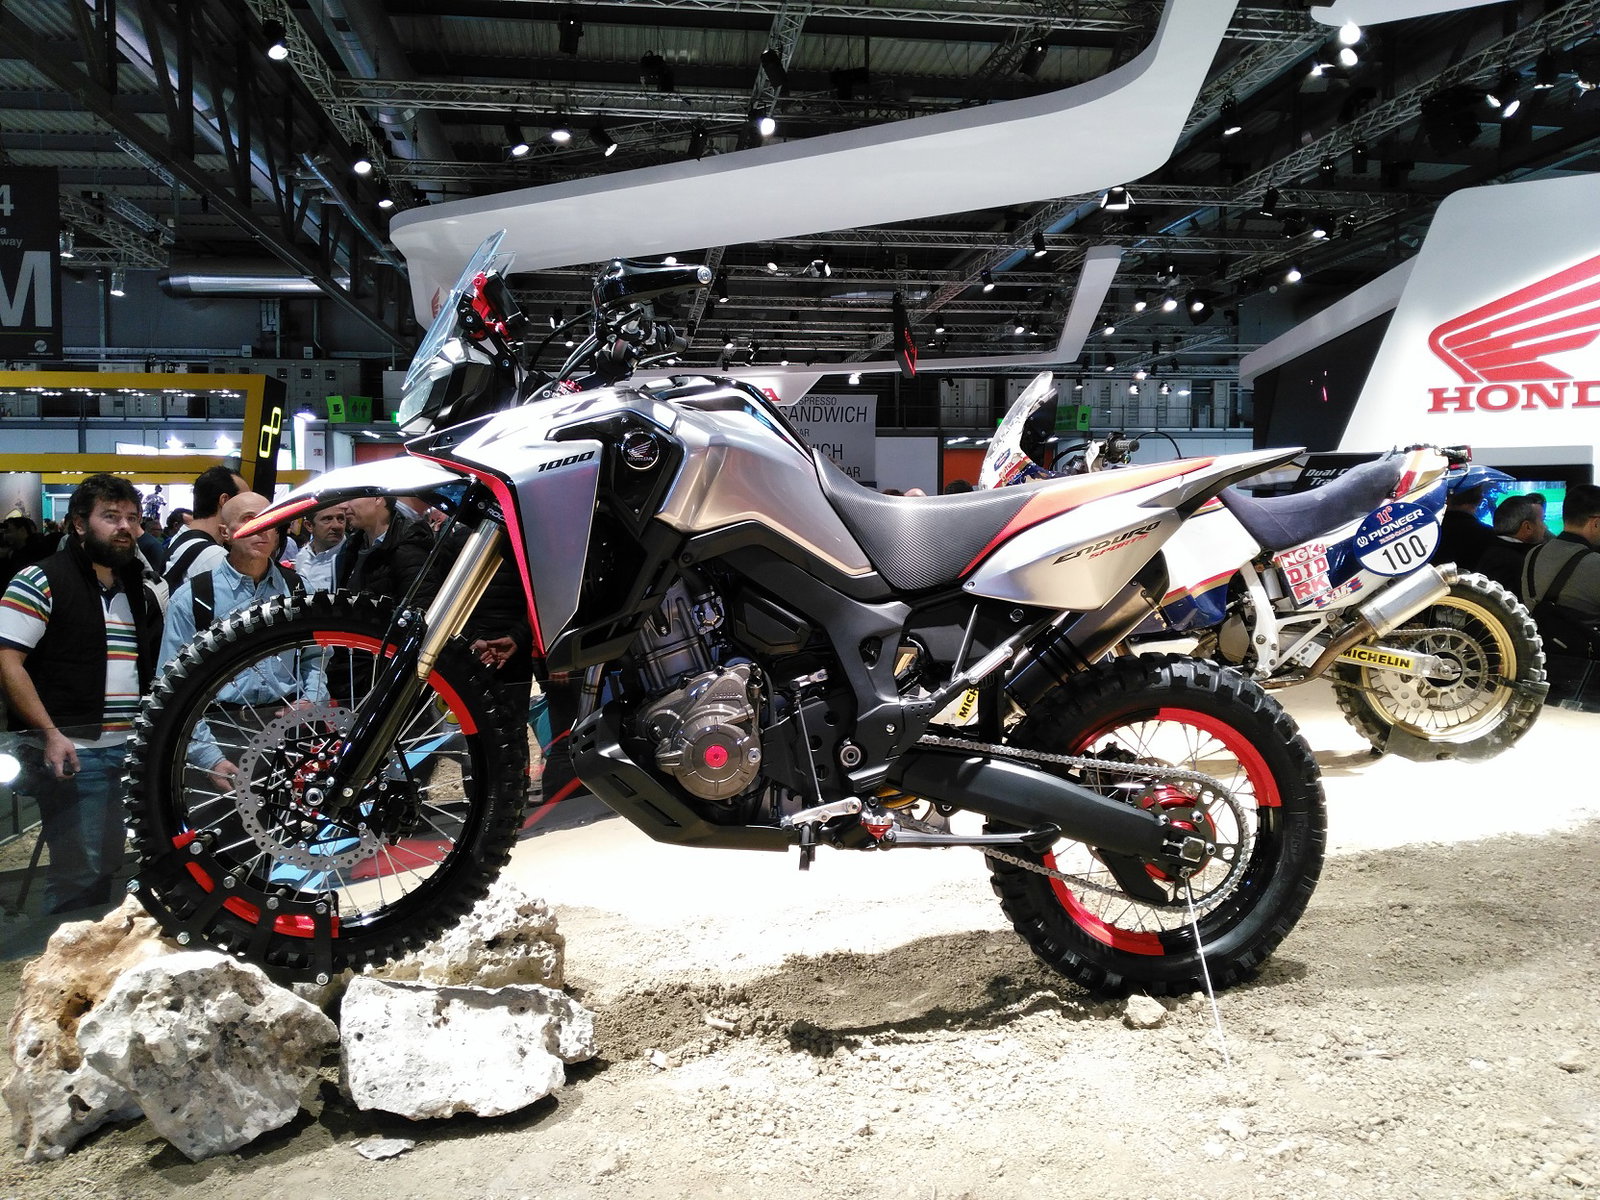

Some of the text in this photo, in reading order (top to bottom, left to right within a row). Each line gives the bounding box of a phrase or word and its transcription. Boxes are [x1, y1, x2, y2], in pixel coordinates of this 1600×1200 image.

[538, 450, 595, 473] 1000
[841, 466, 861, 478] AR
[1305, 468, 1337, 477] Dual
[1368, 508, 1425, 542] PIONEER
[1051, 520, 1162, 566] ENDURO
[1087, 533, 1149, 560] SPORTS
[1382, 534, 1427, 571] 100
[1281, 544, 1319, 569] NGK
[1292, 574, 1329, 600] RK
